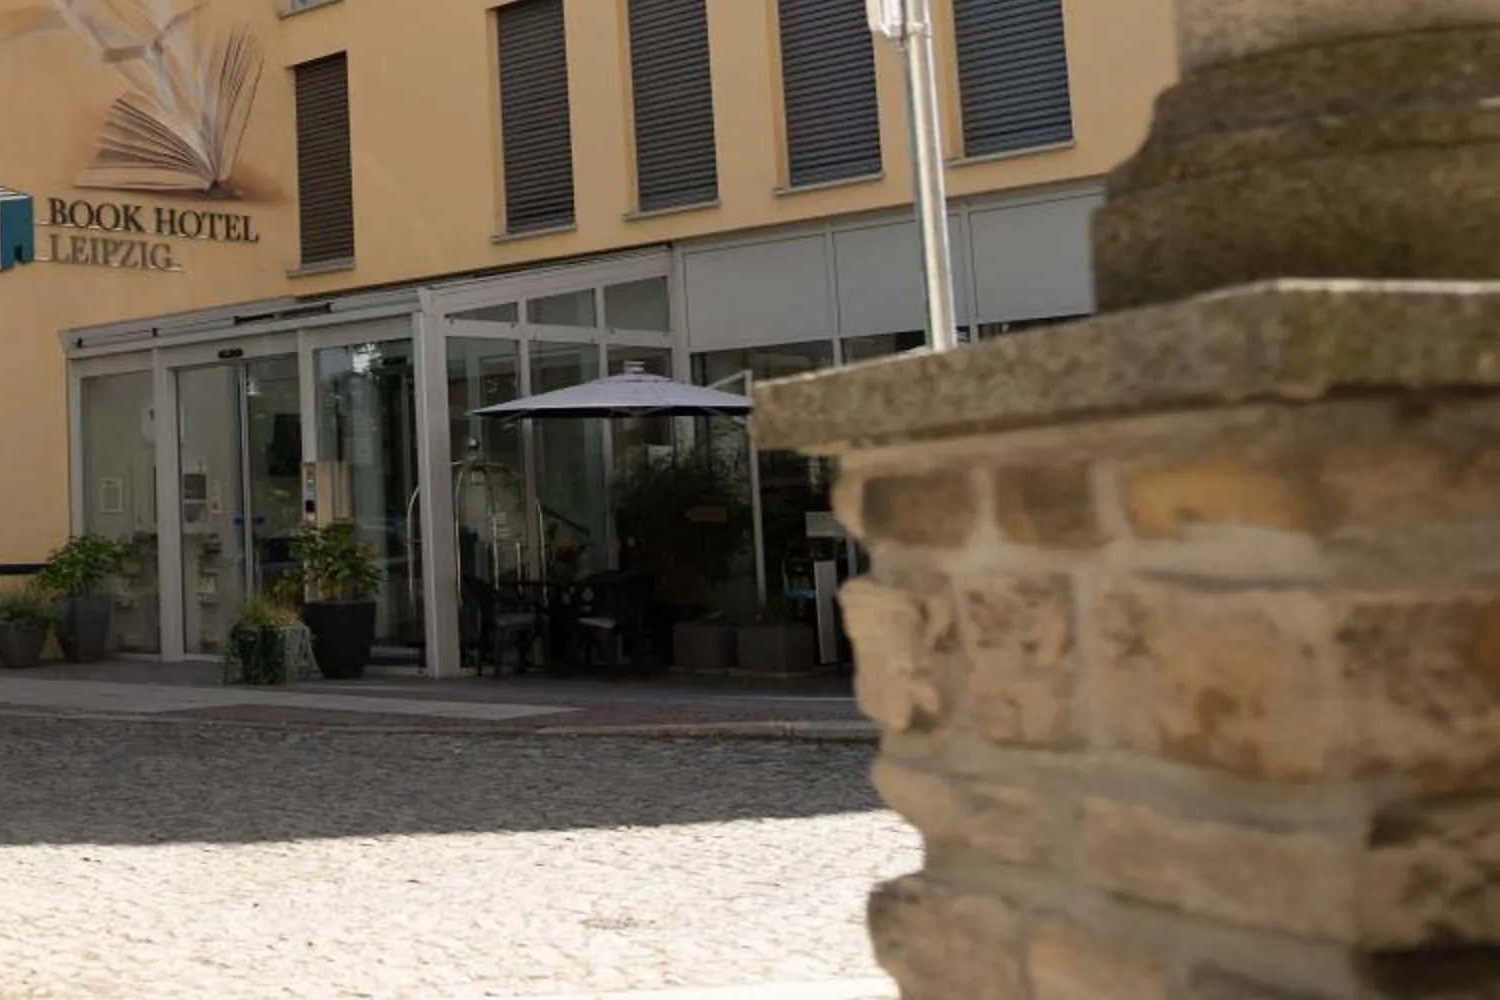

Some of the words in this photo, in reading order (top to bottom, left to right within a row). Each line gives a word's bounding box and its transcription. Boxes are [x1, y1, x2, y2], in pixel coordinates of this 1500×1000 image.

[48, 197, 146, 233] BOOK
[155, 207, 260, 244] HOTEL
[49, 233, 175, 271] LEIPZIG
